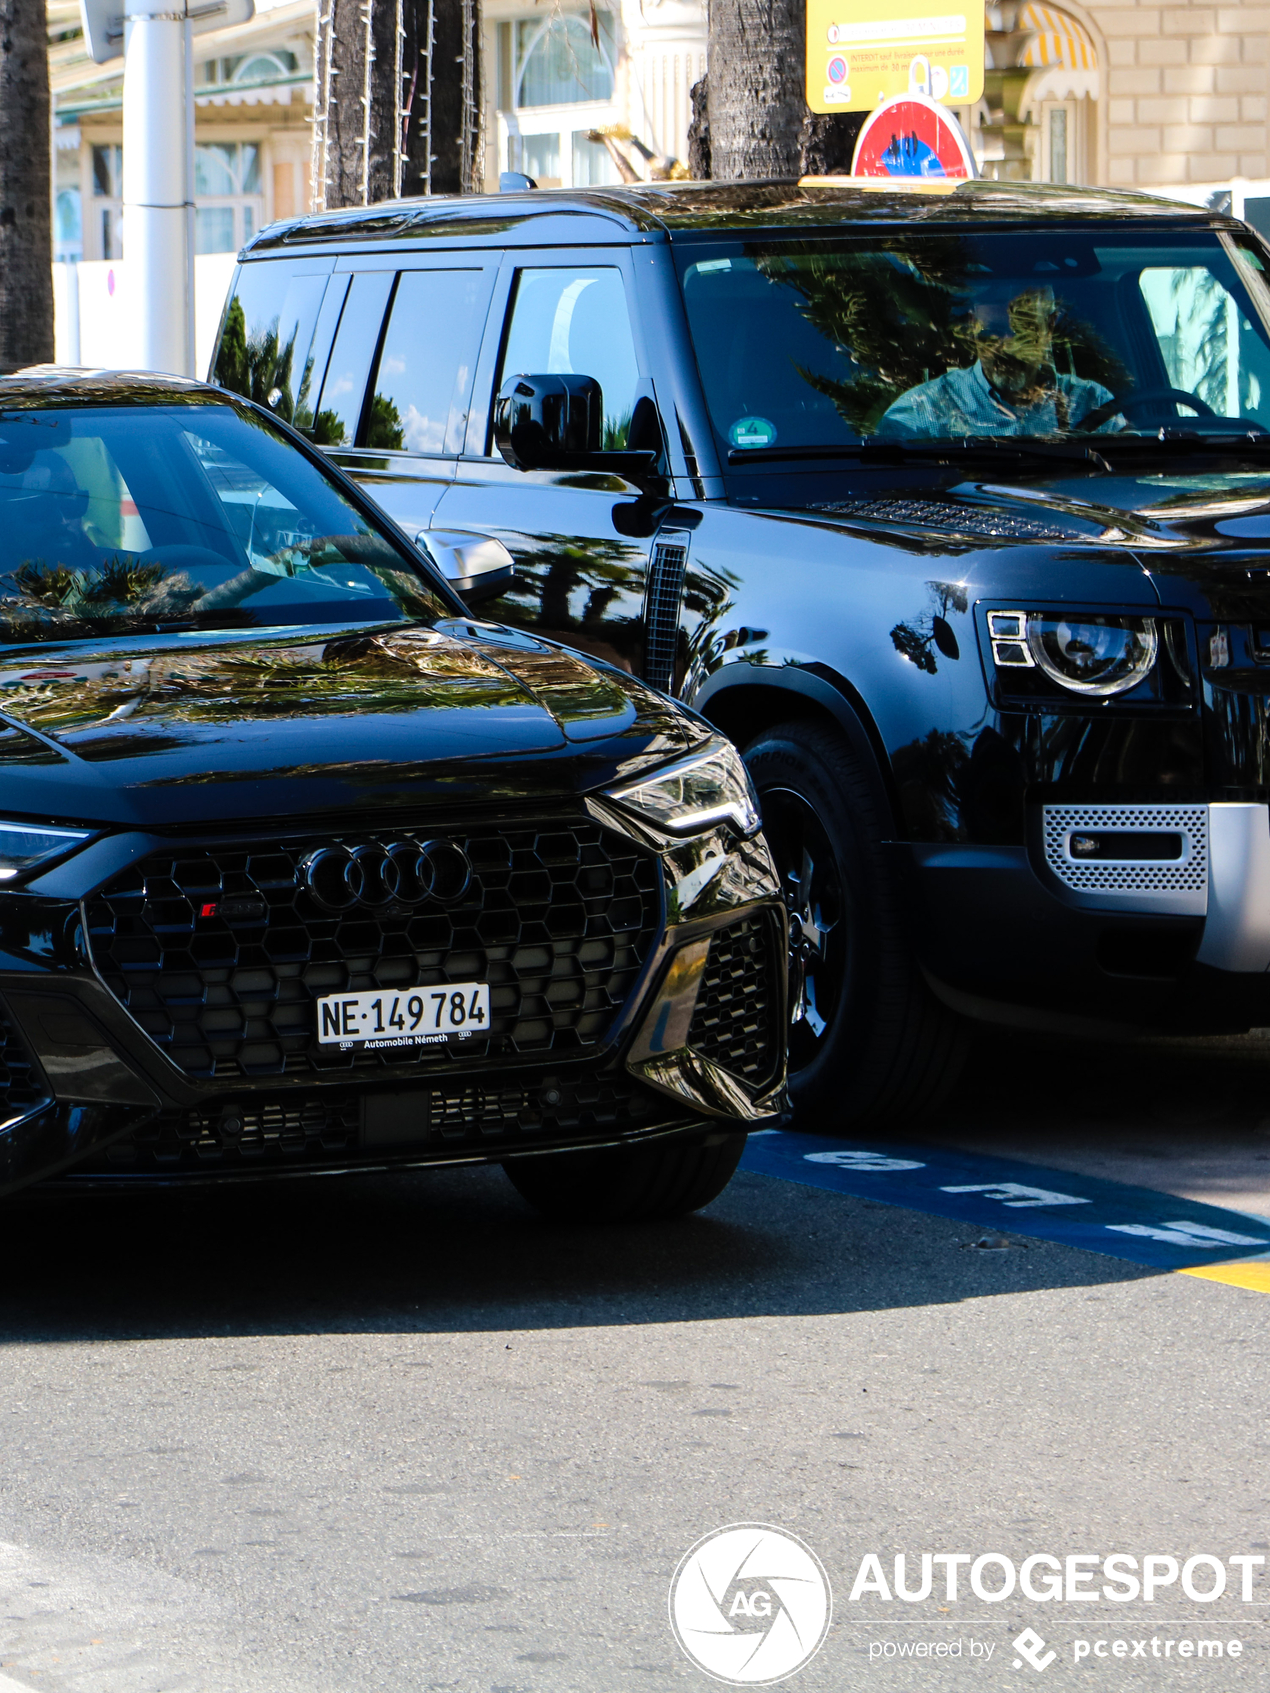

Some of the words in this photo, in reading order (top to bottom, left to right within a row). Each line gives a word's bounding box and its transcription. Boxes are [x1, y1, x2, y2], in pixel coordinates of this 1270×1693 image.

[851, 53, 878, 63] INTERDIT
[880, 52, 892, 60] sauf
[947, 48, 965, 57] durée
[851, 64, 879, 73] maximum
[881, 63, 889, 71] de
[891, 63, 900, 72] 30
[747, 421, 758, 434] 4
[363, 1035, 414, 1049] Automobile
[415, 1033, 449, 1046] Németh
